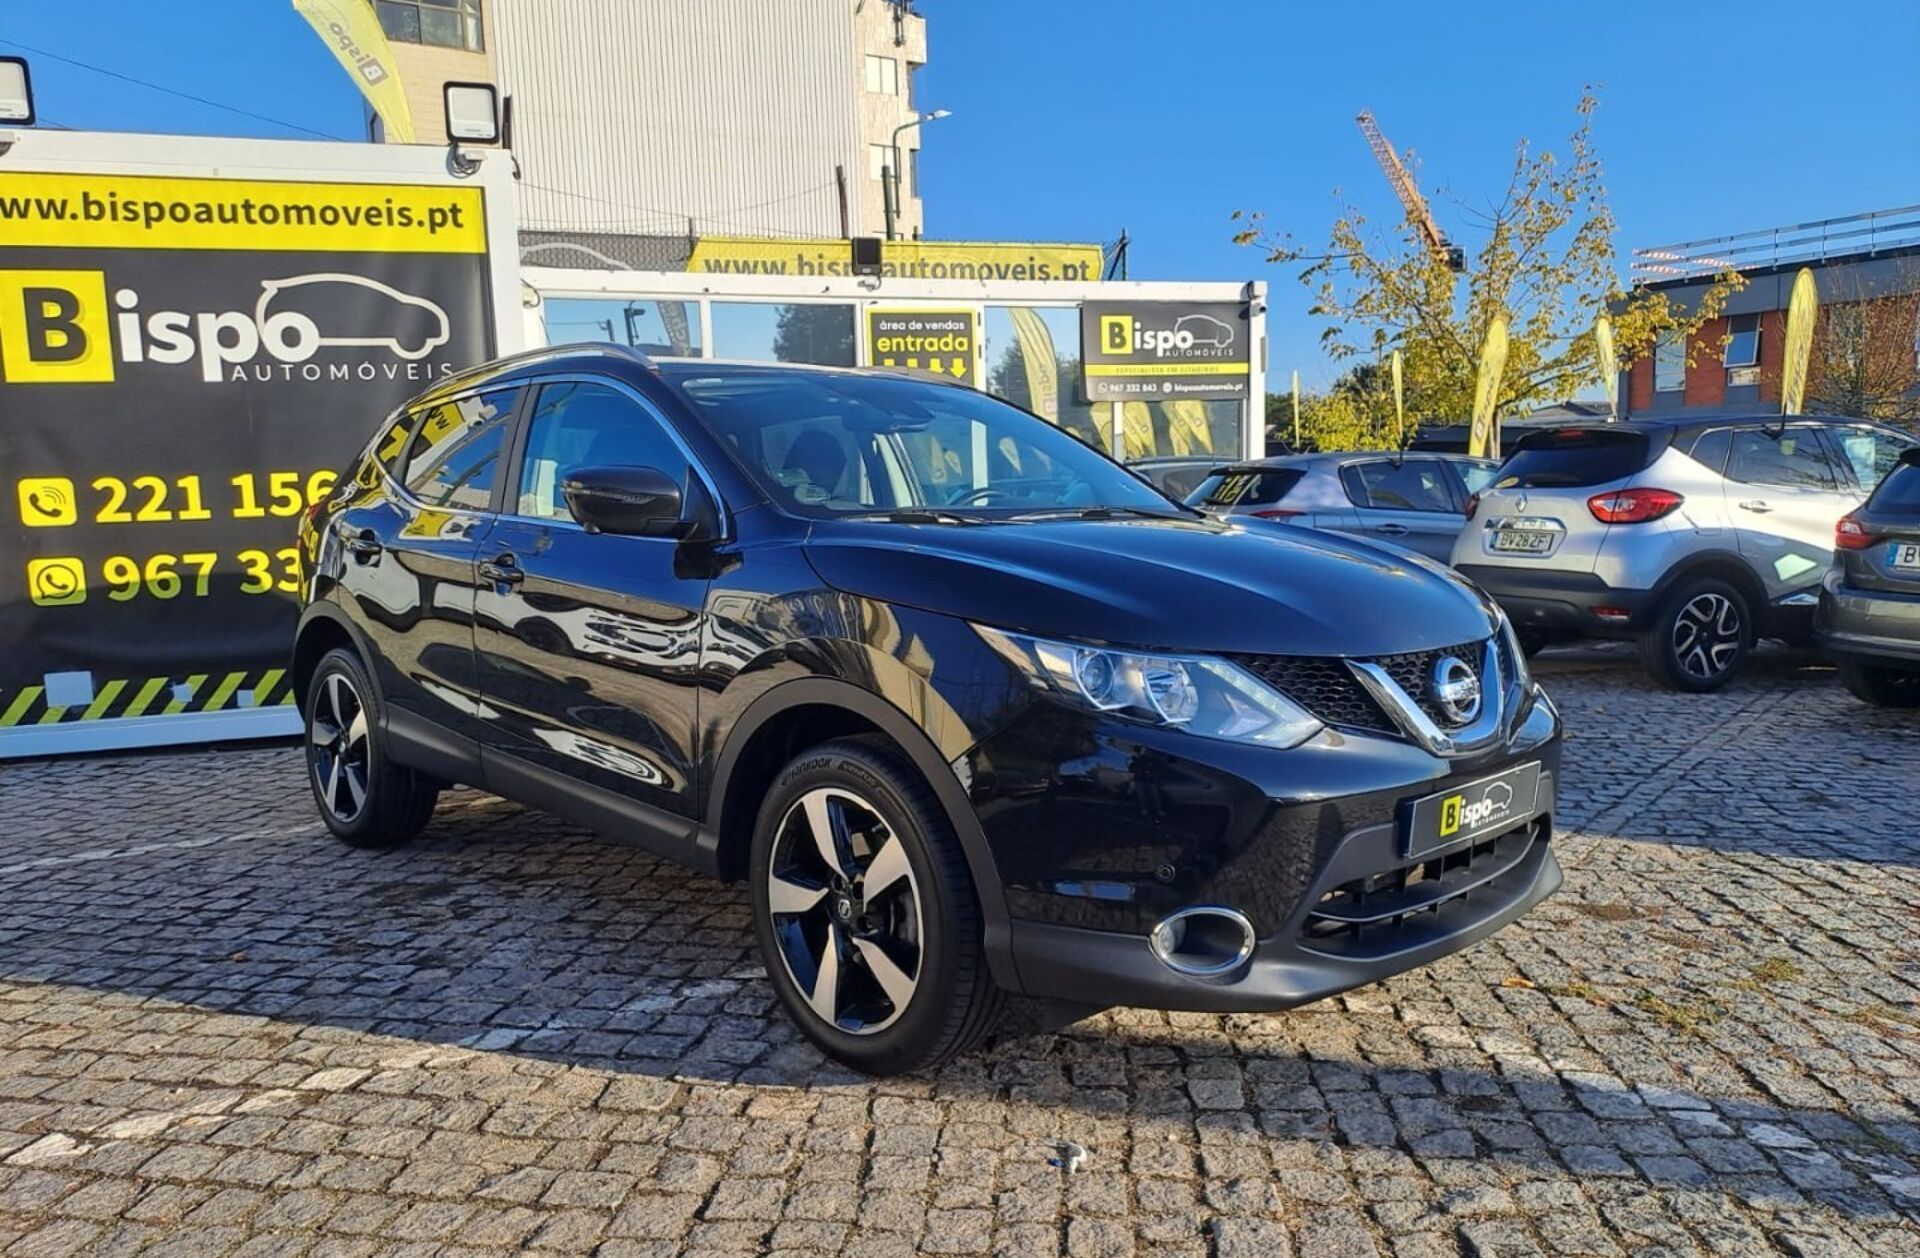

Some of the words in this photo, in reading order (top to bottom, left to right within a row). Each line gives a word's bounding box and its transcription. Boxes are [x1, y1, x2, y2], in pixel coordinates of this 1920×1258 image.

[22, 287, 321, 382] Bispo
[879, 320, 906, 331] área
[908, 320, 924, 331] de
[924, 320, 965, 331] vendas
[877, 333, 969, 352] entrada
[1109, 321, 1194, 357] Bispo
[1164, 348, 1234, 357] AUTOMÓVEIS
[232, 361, 454, 382] AUTOMÓVEIS
[91, 475, 212, 523] 221
[1904, 547, 1919, 563] B
[103, 553, 218, 601] 967
[1446, 798, 1492, 829] Bispo
